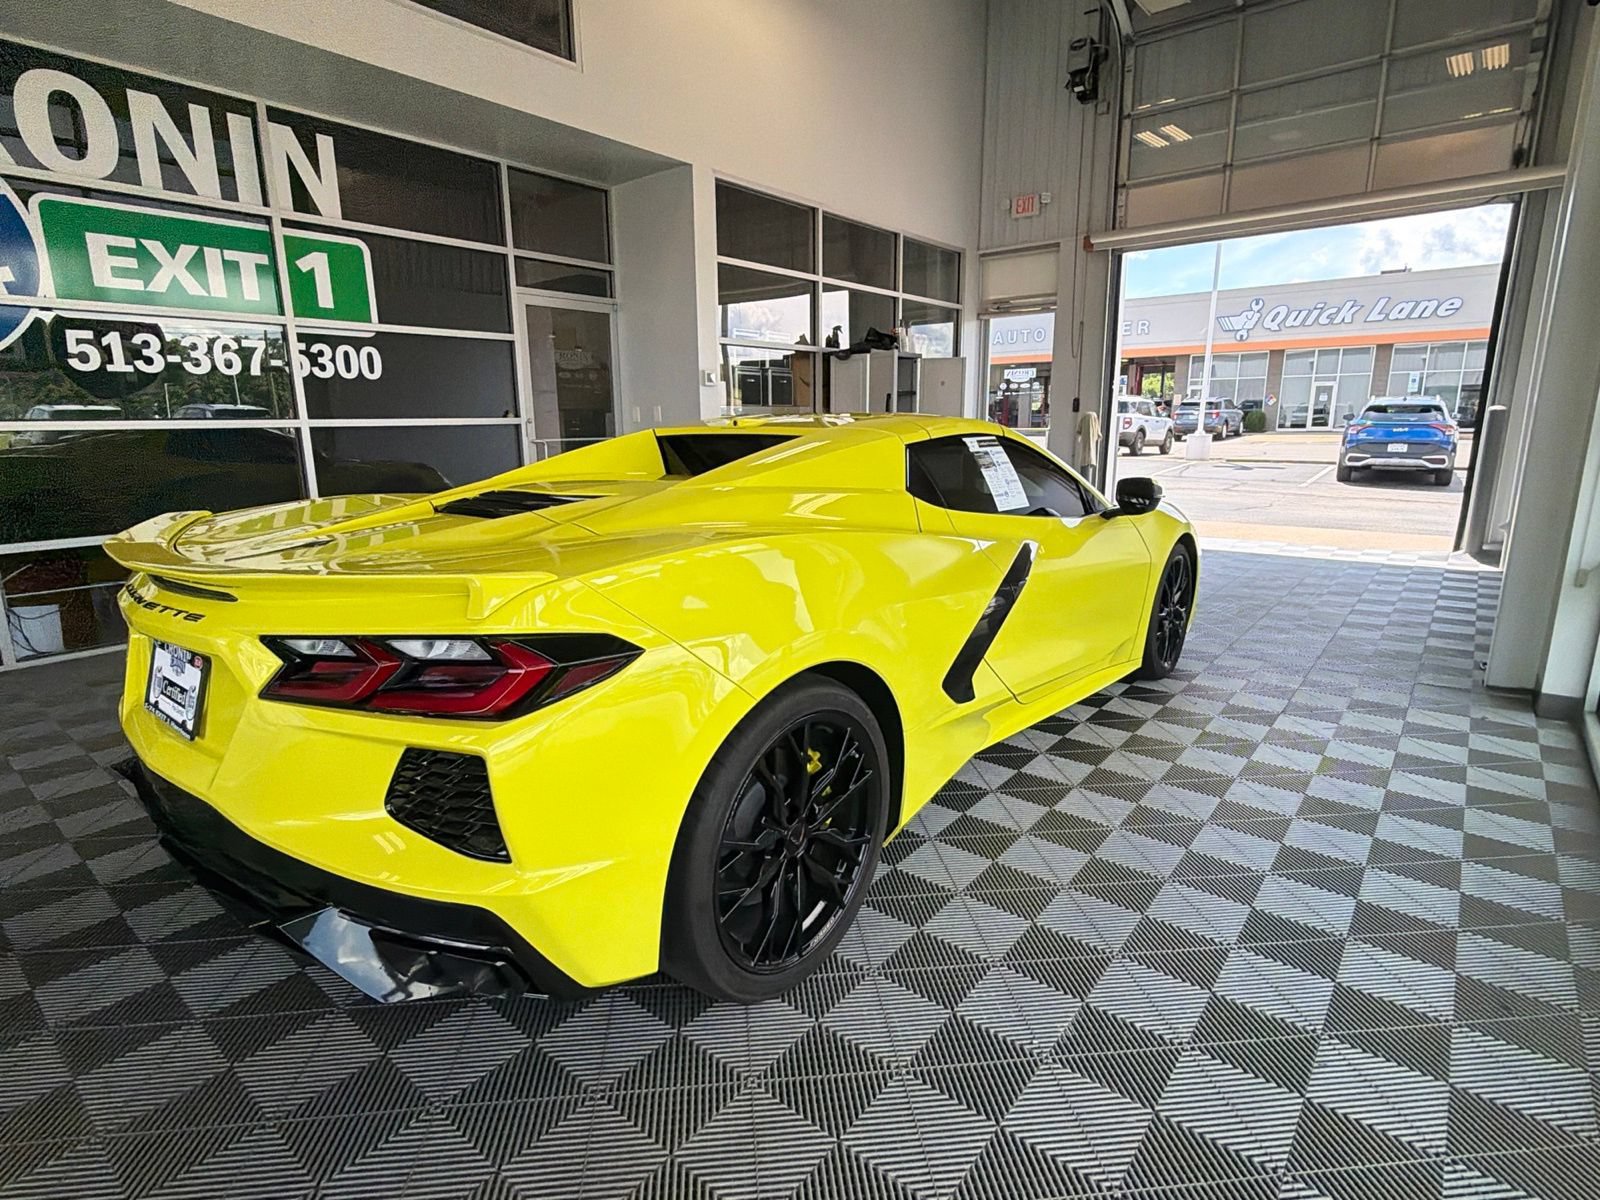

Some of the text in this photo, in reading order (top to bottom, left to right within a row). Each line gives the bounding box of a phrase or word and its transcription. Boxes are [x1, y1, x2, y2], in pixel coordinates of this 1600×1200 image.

[0, 68, 341, 219] ONIN
[1016, 196, 1034, 214] EXIT
[85, 231, 271, 300] EXIT
[295, 252, 336, 309] 1
[1263, 297, 1463, 331] Quick Lane
[65, 329, 382, 381] 513-367-5300
[992, 328, 1046, 345] AUTO
